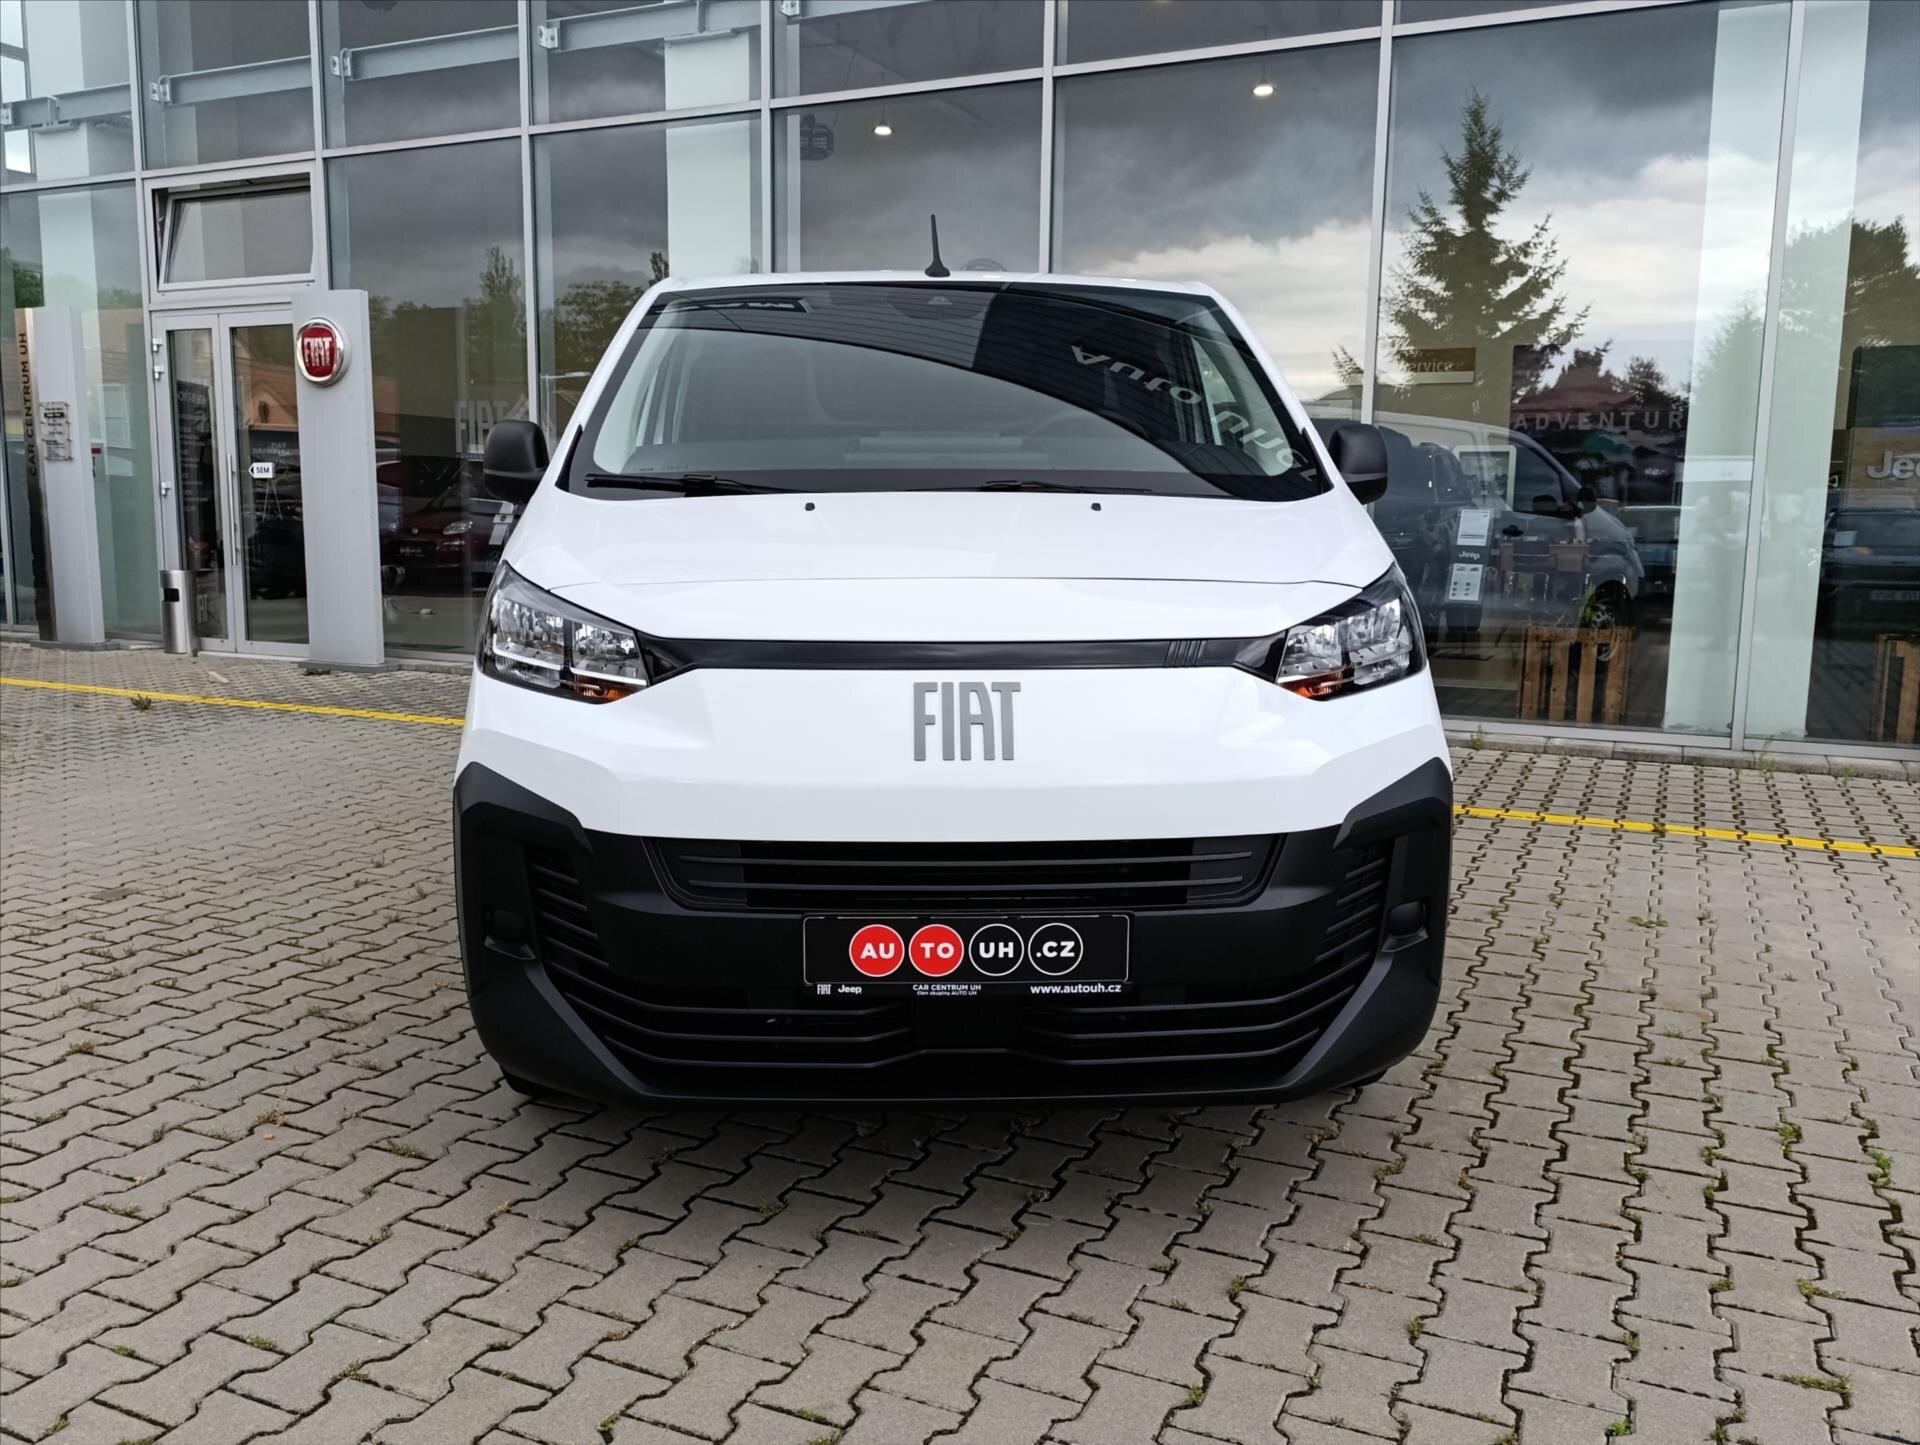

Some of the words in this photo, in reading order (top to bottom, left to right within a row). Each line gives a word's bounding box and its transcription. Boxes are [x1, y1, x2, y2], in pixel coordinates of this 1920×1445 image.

[18, 333, 29, 356] UH
[303, 336, 333, 366] FIAT
[20, 361, 34, 439] CENTRUM
[1513, 410, 1684, 431] ADVENTUR
[28, 443, 38, 478] CAR
[1866, 447, 1920, 480] Je
[255, 466, 270, 475] SEM
[1458, 550, 1481, 562] Jeep
[913, 681, 1022, 761] FIAT
[860, 942, 895, 959] AU
[919, 942, 956, 959] TO
[979, 941, 1014, 958] UH
[817, 984, 832, 995] FIAT
[837, 984, 863, 995] Jeep
[969, 983, 982, 991] UH
[1030, 982, 1122, 994] www.autouh.cz
